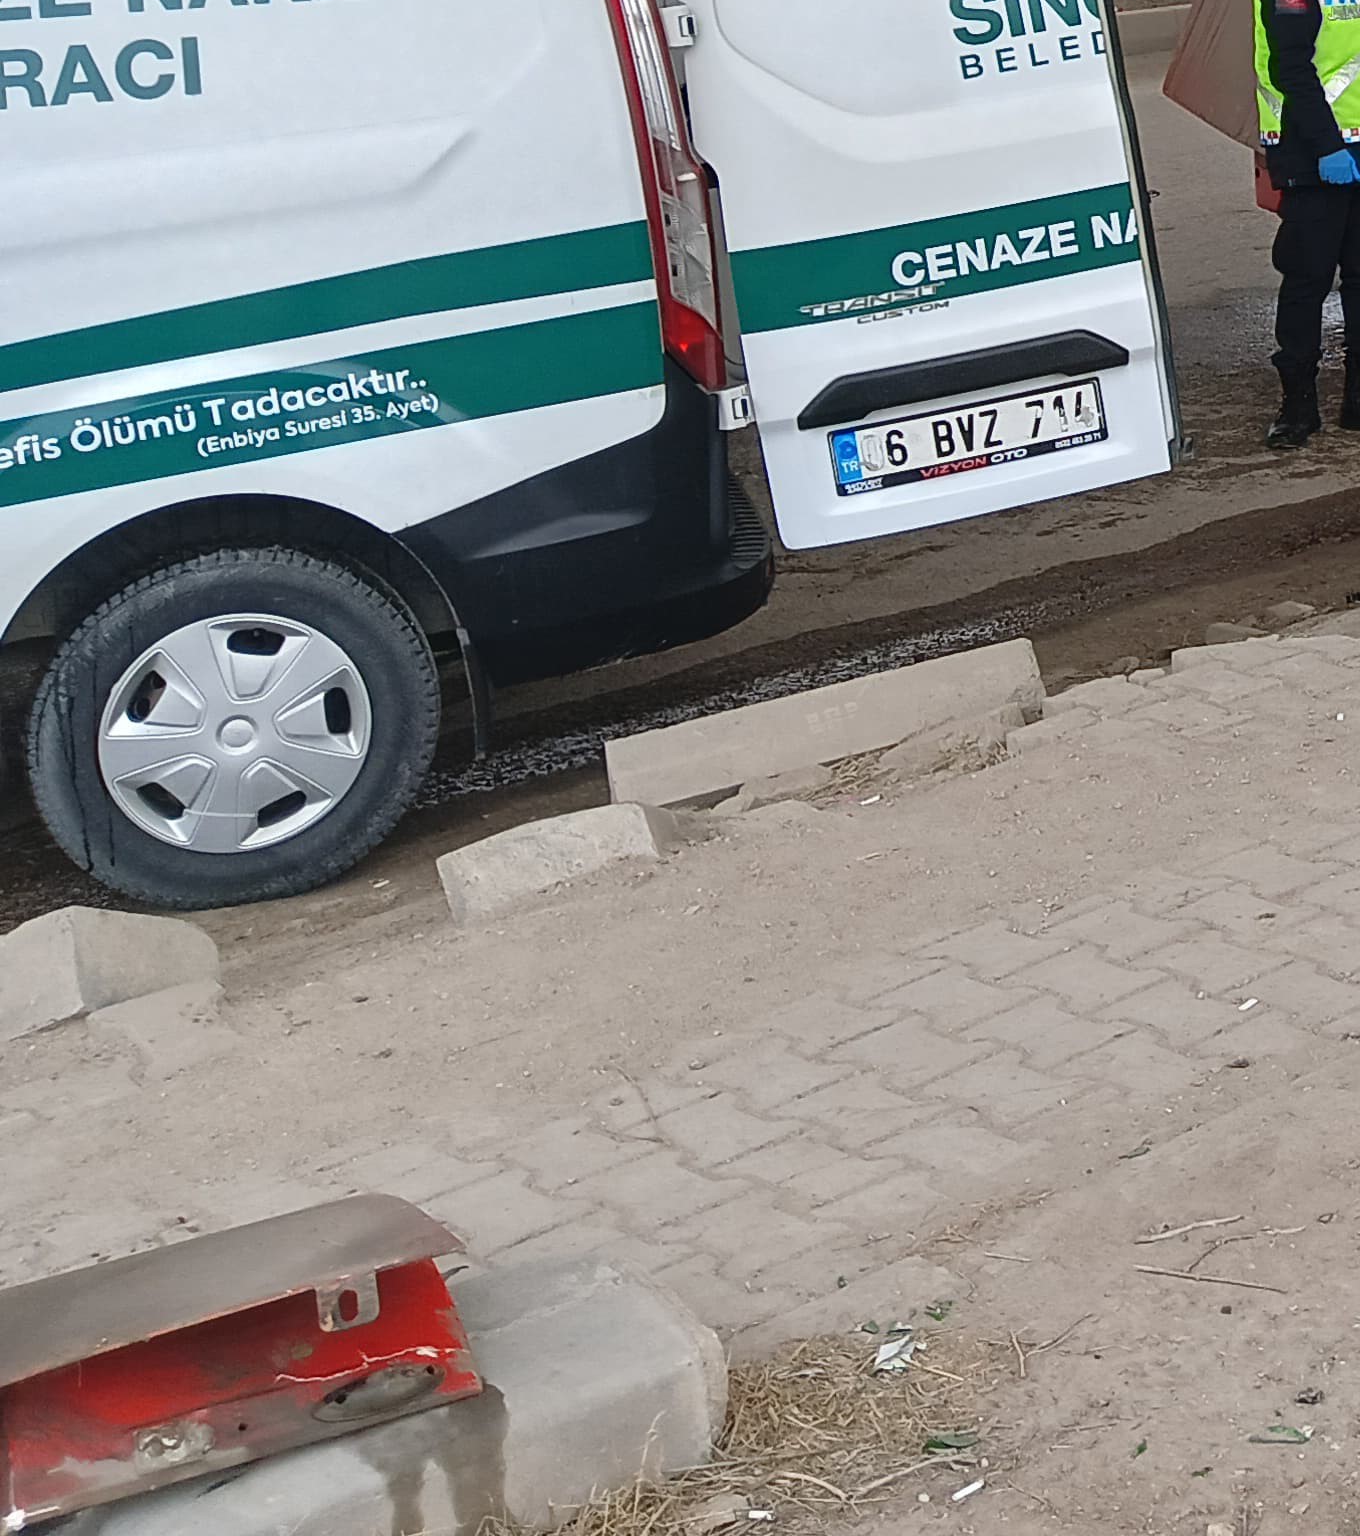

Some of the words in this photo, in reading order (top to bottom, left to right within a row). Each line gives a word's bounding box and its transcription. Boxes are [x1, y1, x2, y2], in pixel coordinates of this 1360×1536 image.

[891, 220, 1080, 288] CENAZE
[797, 279, 946, 318] TRANSIT
[856, 300, 950, 324] CUSTOM
[70, 405, 197, 452] Ölümü
[197, 425, 281, 458] (Enbiya
[285, 411, 347, 438] Suresi
[350, 405, 382, 426] 35.
[385, 393, 440, 421] Ayet)
[841, 460, 860, 474] TR
[931, 409, 1003, 459] BVZ
[1025, 390, 1096, 440] 714
[990, 448, 1028, 466] OTO
